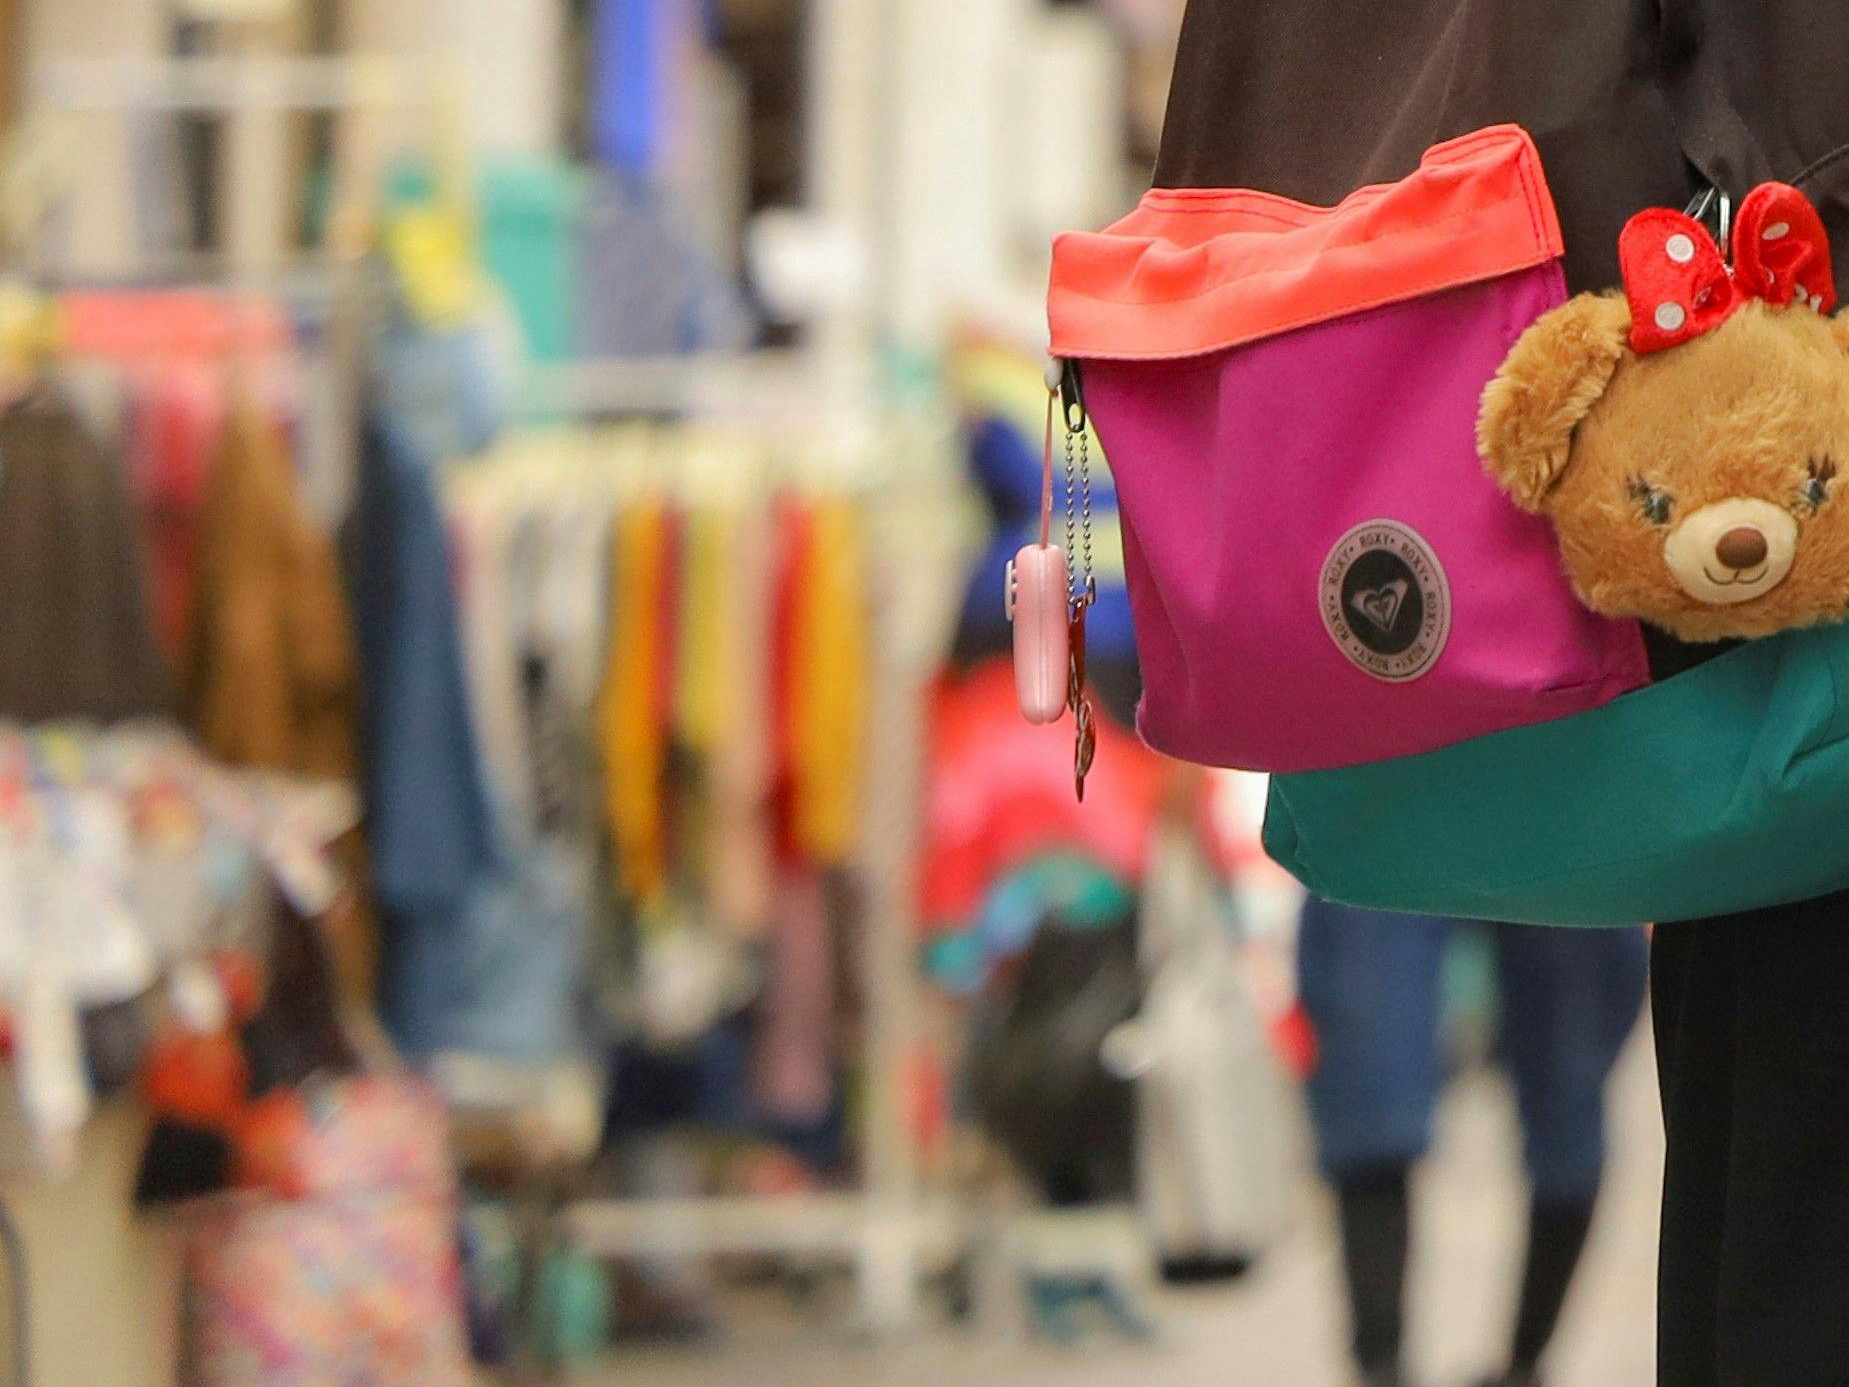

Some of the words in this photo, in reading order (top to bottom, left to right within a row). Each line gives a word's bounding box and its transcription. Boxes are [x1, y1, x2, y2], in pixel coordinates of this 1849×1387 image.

[1328, 548, 1351, 585] ROXY
[1359, 532, 1389, 546] ROXY
[1400, 541, 1426, 574] ROXY
